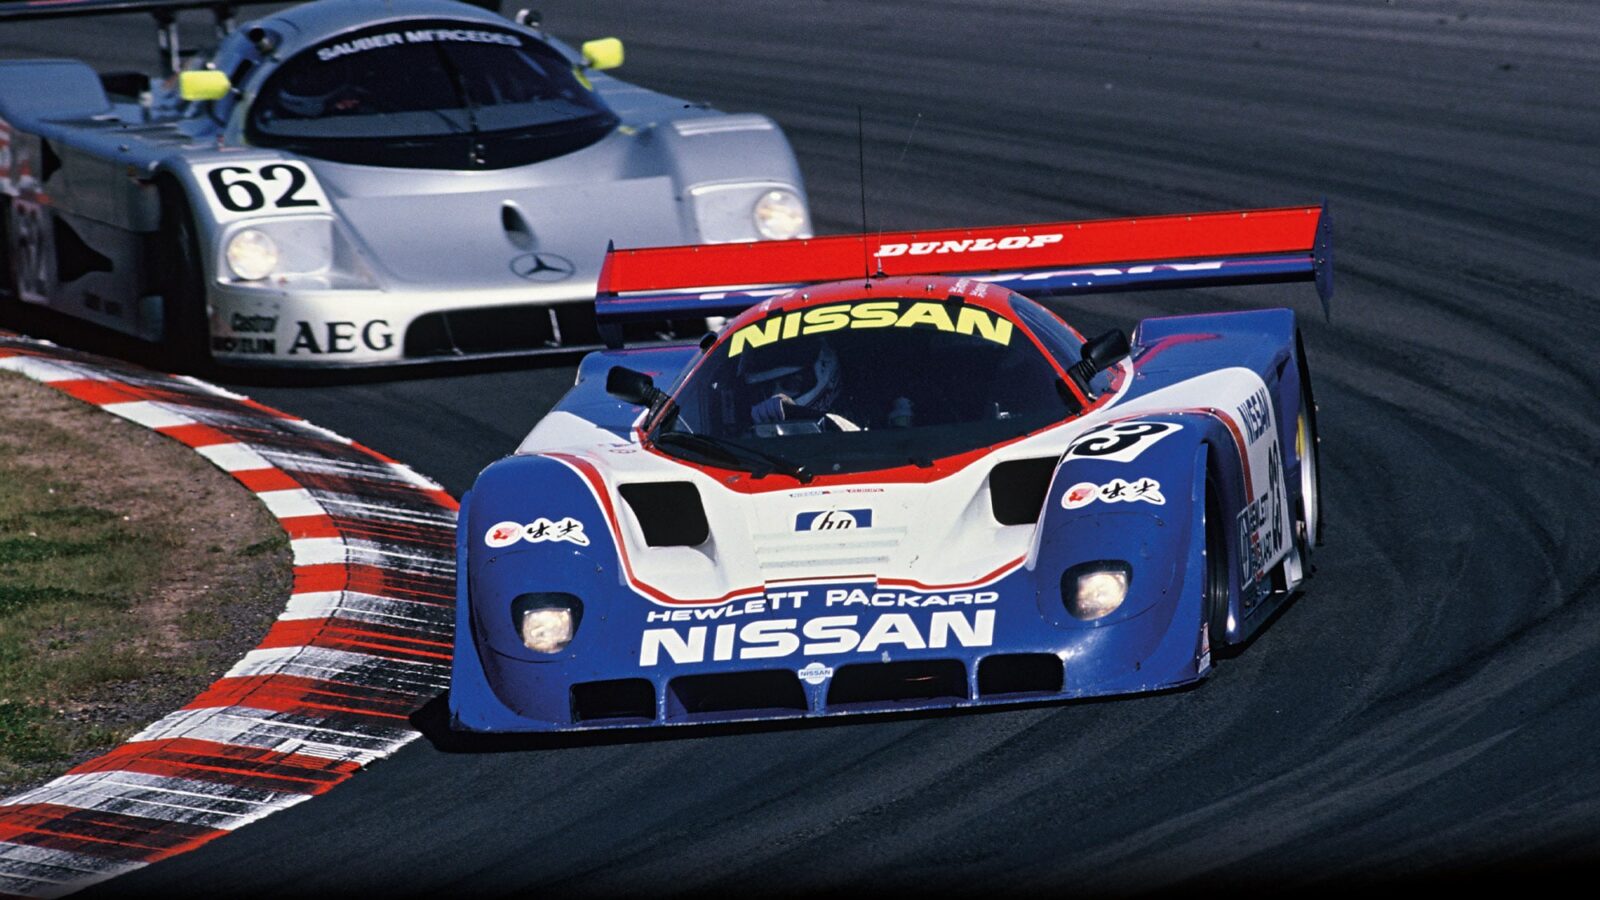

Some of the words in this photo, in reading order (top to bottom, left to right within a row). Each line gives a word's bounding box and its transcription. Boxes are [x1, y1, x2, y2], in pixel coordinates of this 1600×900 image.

[316, 33, 404, 61] SAUBER
[405, 29, 522, 47] MERCEDES
[208, 164, 319, 212] 62
[873, 234, 1064, 257] DUNLOP
[287, 319, 395, 354] AEG
[728, 301, 1013, 358] NISSAN
[1236, 386, 1272, 444] NISSAN
[646, 590, 809, 623] HEWLETT
[825, 588, 1000, 608] PACKARD
[639, 609, 997, 667] NISSAN
[799, 669, 832, 678] NISSAN
